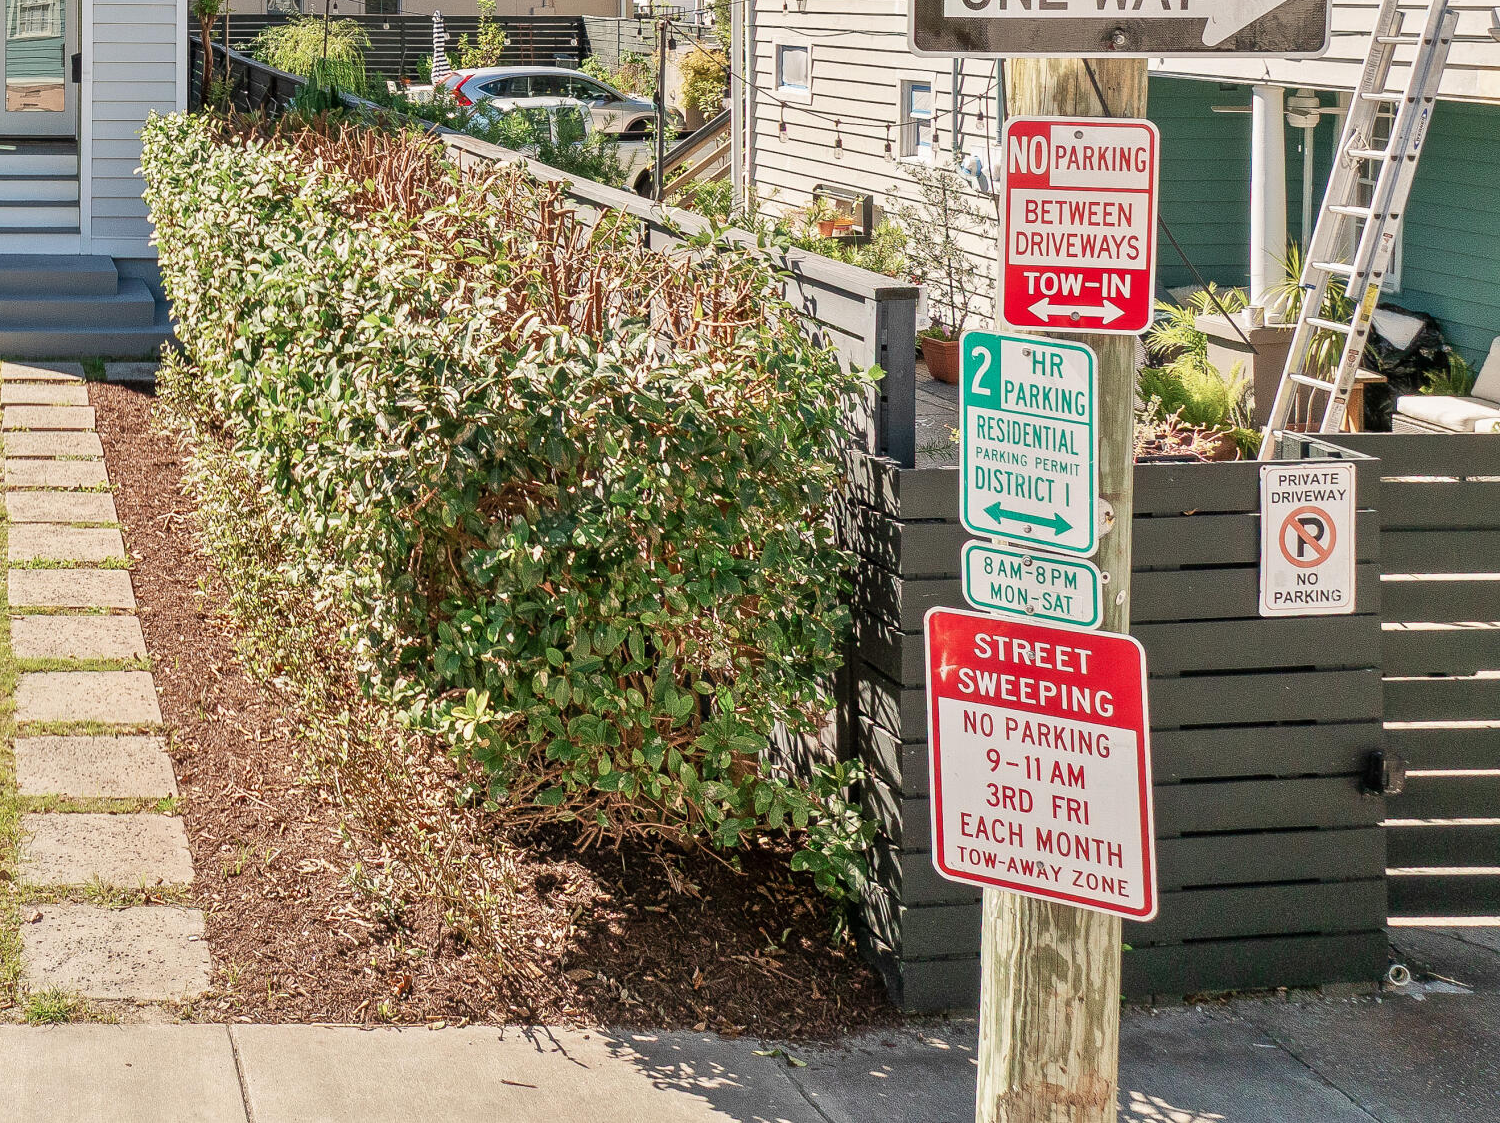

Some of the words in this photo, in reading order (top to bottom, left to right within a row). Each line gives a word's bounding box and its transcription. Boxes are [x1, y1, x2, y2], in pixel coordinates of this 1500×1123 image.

[1008, 134, 1049, 176] NO
[1054, 145, 1147, 174] PARKING
[1024, 199, 1133, 228] BETWEEN
[1014, 231, 1140, 261] DRIVEWAYS
[1023, 271, 1132, 299] TOW-IN
[971, 345, 992, 397] 2
[1032, 349, 1064, 379] HR
[1004, 379, 1085, 417] PARKING
[976, 414, 1079, 456] RESIDENTIAL
[975, 446, 1028, 467] PARKING
[1035, 457, 1080, 477] PERMIT
[1278, 472, 1339, 487] PRIVATE
[975, 465, 1055, 504] DISTRICT
[1271, 489, 1347, 504] DRIVEWAY
[990, 581, 1074, 615] MON-SAT
[1273, 589, 1342, 605] PARKING
[1296, 572, 1319, 586] NO
[973, 632, 1092, 675] STREET
[956, 667, 1115, 718] SWEEPING
[962, 709, 995, 738] NO
[1005, 717, 1111, 759] PARKING
[985, 782, 1034, 814] 3RD
[1052, 795, 1090, 826] FRI
[960, 812, 1024, 848] EACH
[1035, 829, 1123, 869] MONTH
[956, 845, 1062, 883] TOW-AWAY
[1072, 869, 1130, 898] ZONE
